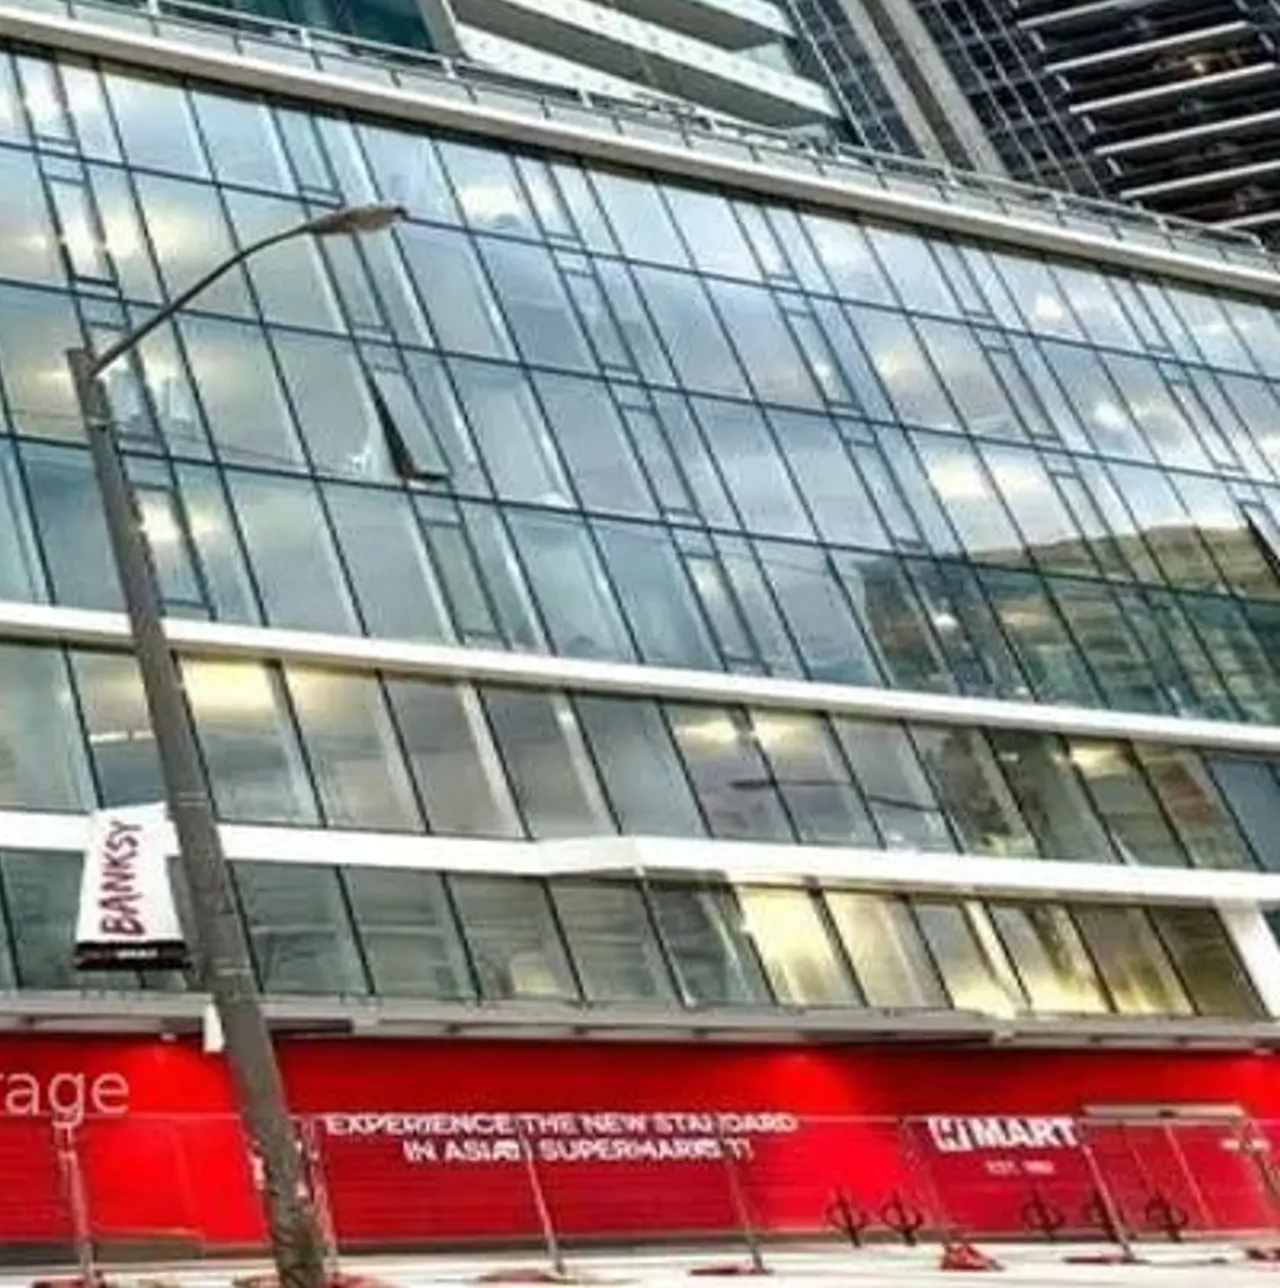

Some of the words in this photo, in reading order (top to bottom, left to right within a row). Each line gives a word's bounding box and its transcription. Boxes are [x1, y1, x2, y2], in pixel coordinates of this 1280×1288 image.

[98, 820, 146, 935] BANKSY
[325, 1113, 514, 1136] EXPERIENCE
[519, 1114, 578, 1133] THE
[583, 1114, 645, 1133] NEW
[966, 1115, 1078, 1148] MART
[403, 1138, 439, 1161] IN
